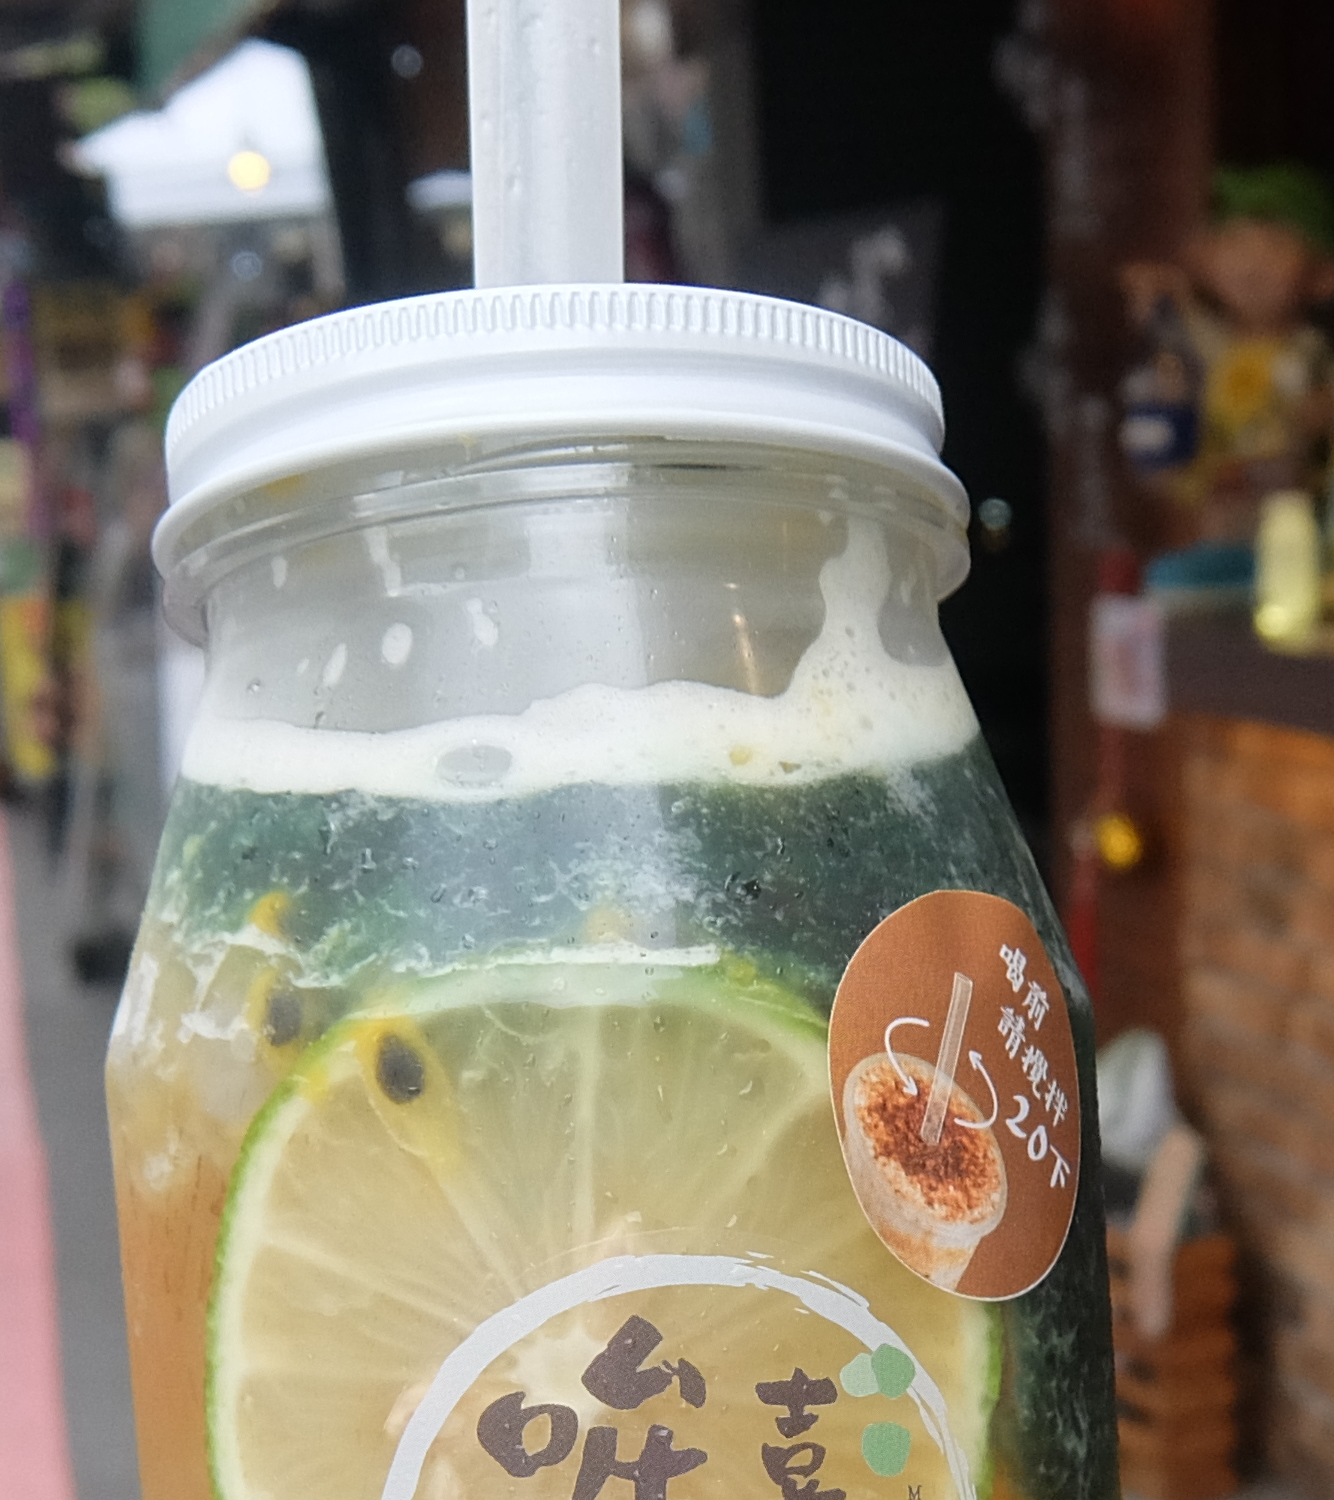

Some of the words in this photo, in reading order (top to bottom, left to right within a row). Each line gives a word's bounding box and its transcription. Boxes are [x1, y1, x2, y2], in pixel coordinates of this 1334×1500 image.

[998, 943, 1050, 1031] 喝前
[997, 1005, 1068, 1127] 請攪拌
[1005, 1094, 1071, 1189] 20下
